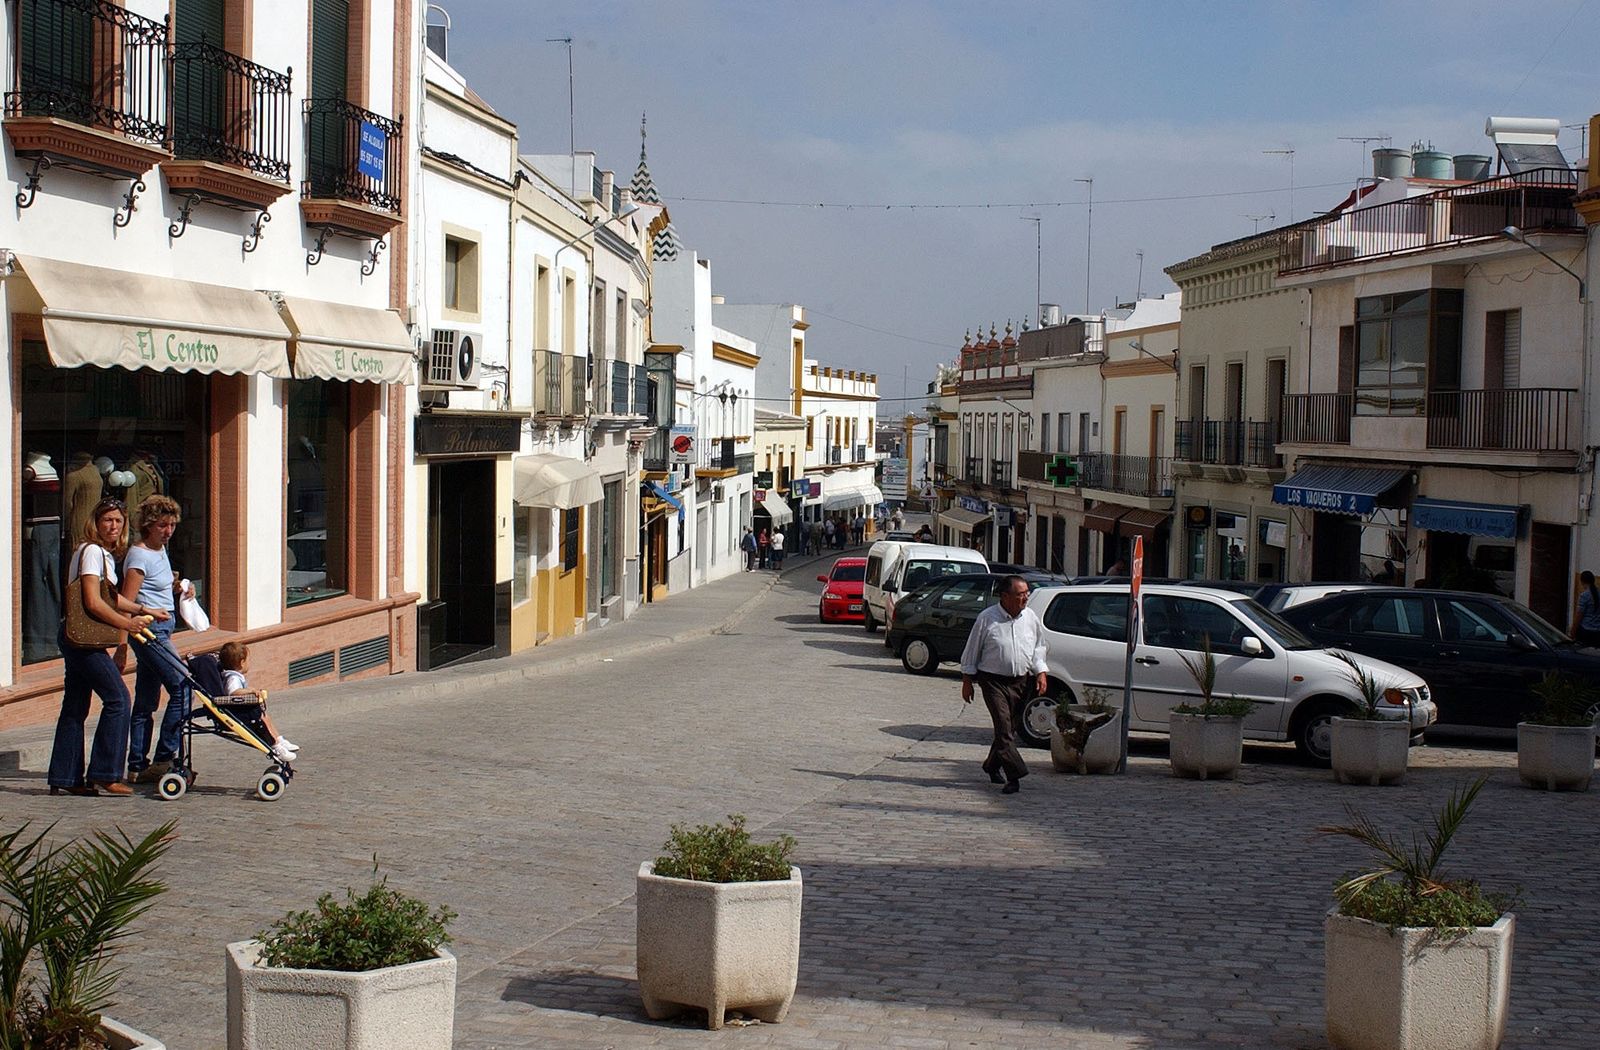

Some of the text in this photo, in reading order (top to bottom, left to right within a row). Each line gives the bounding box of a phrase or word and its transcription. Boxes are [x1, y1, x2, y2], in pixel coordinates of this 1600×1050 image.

[136, 328, 218, 363] El Centro
[335, 348, 383, 374] El Centro
[1287, 488, 1356, 511] LOS VAQUEROS 2
